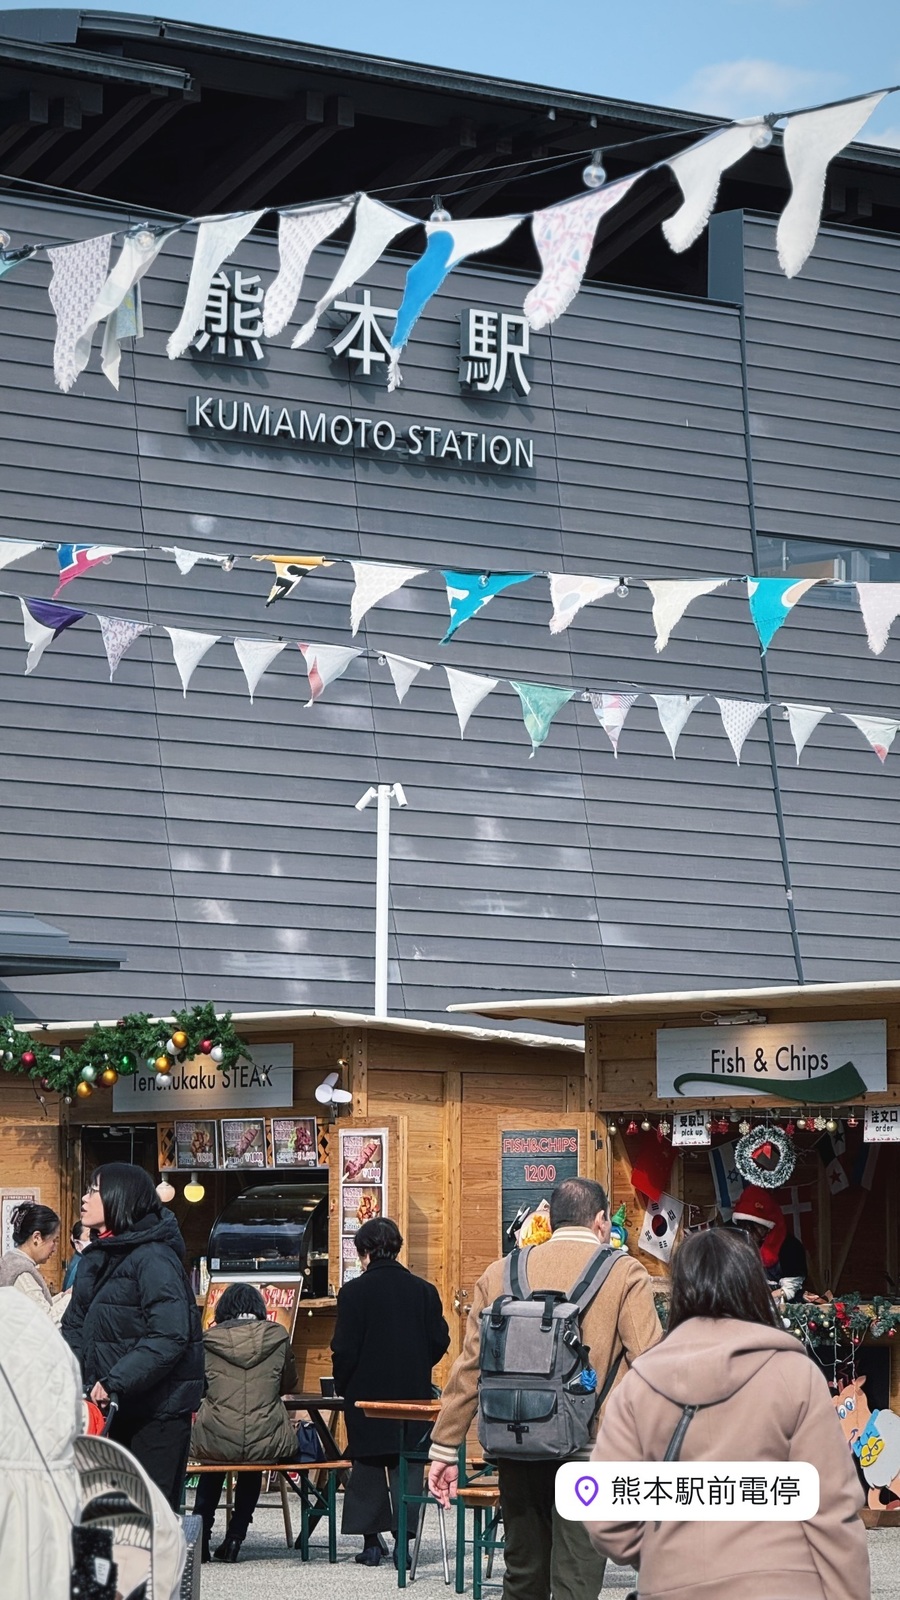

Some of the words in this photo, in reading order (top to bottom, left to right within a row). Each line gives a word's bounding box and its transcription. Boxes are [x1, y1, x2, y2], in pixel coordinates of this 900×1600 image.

[194, 270, 531, 396] 熊本駅
[194, 395, 396, 451] KUMAMOTO
[407, 424, 534, 468] STATION
[711, 1046, 745, 1073] Fish
[753, 1047, 768, 1072] &
[775, 1044, 829, 1078] Chips
[133, 1066, 216, 1092] Tenukaku
[221, 1064, 273, 1089] STEAK
[680, 1115, 704, 1127] 受取口
[871, 1110, 898, 1123] 注文口
[681, 1129, 693, 1137] pick
[875, 1124, 894, 1132] order
[503, 1137, 577, 1153] FISH&CHIPS
[524, 1164, 556, 1182] 1200
